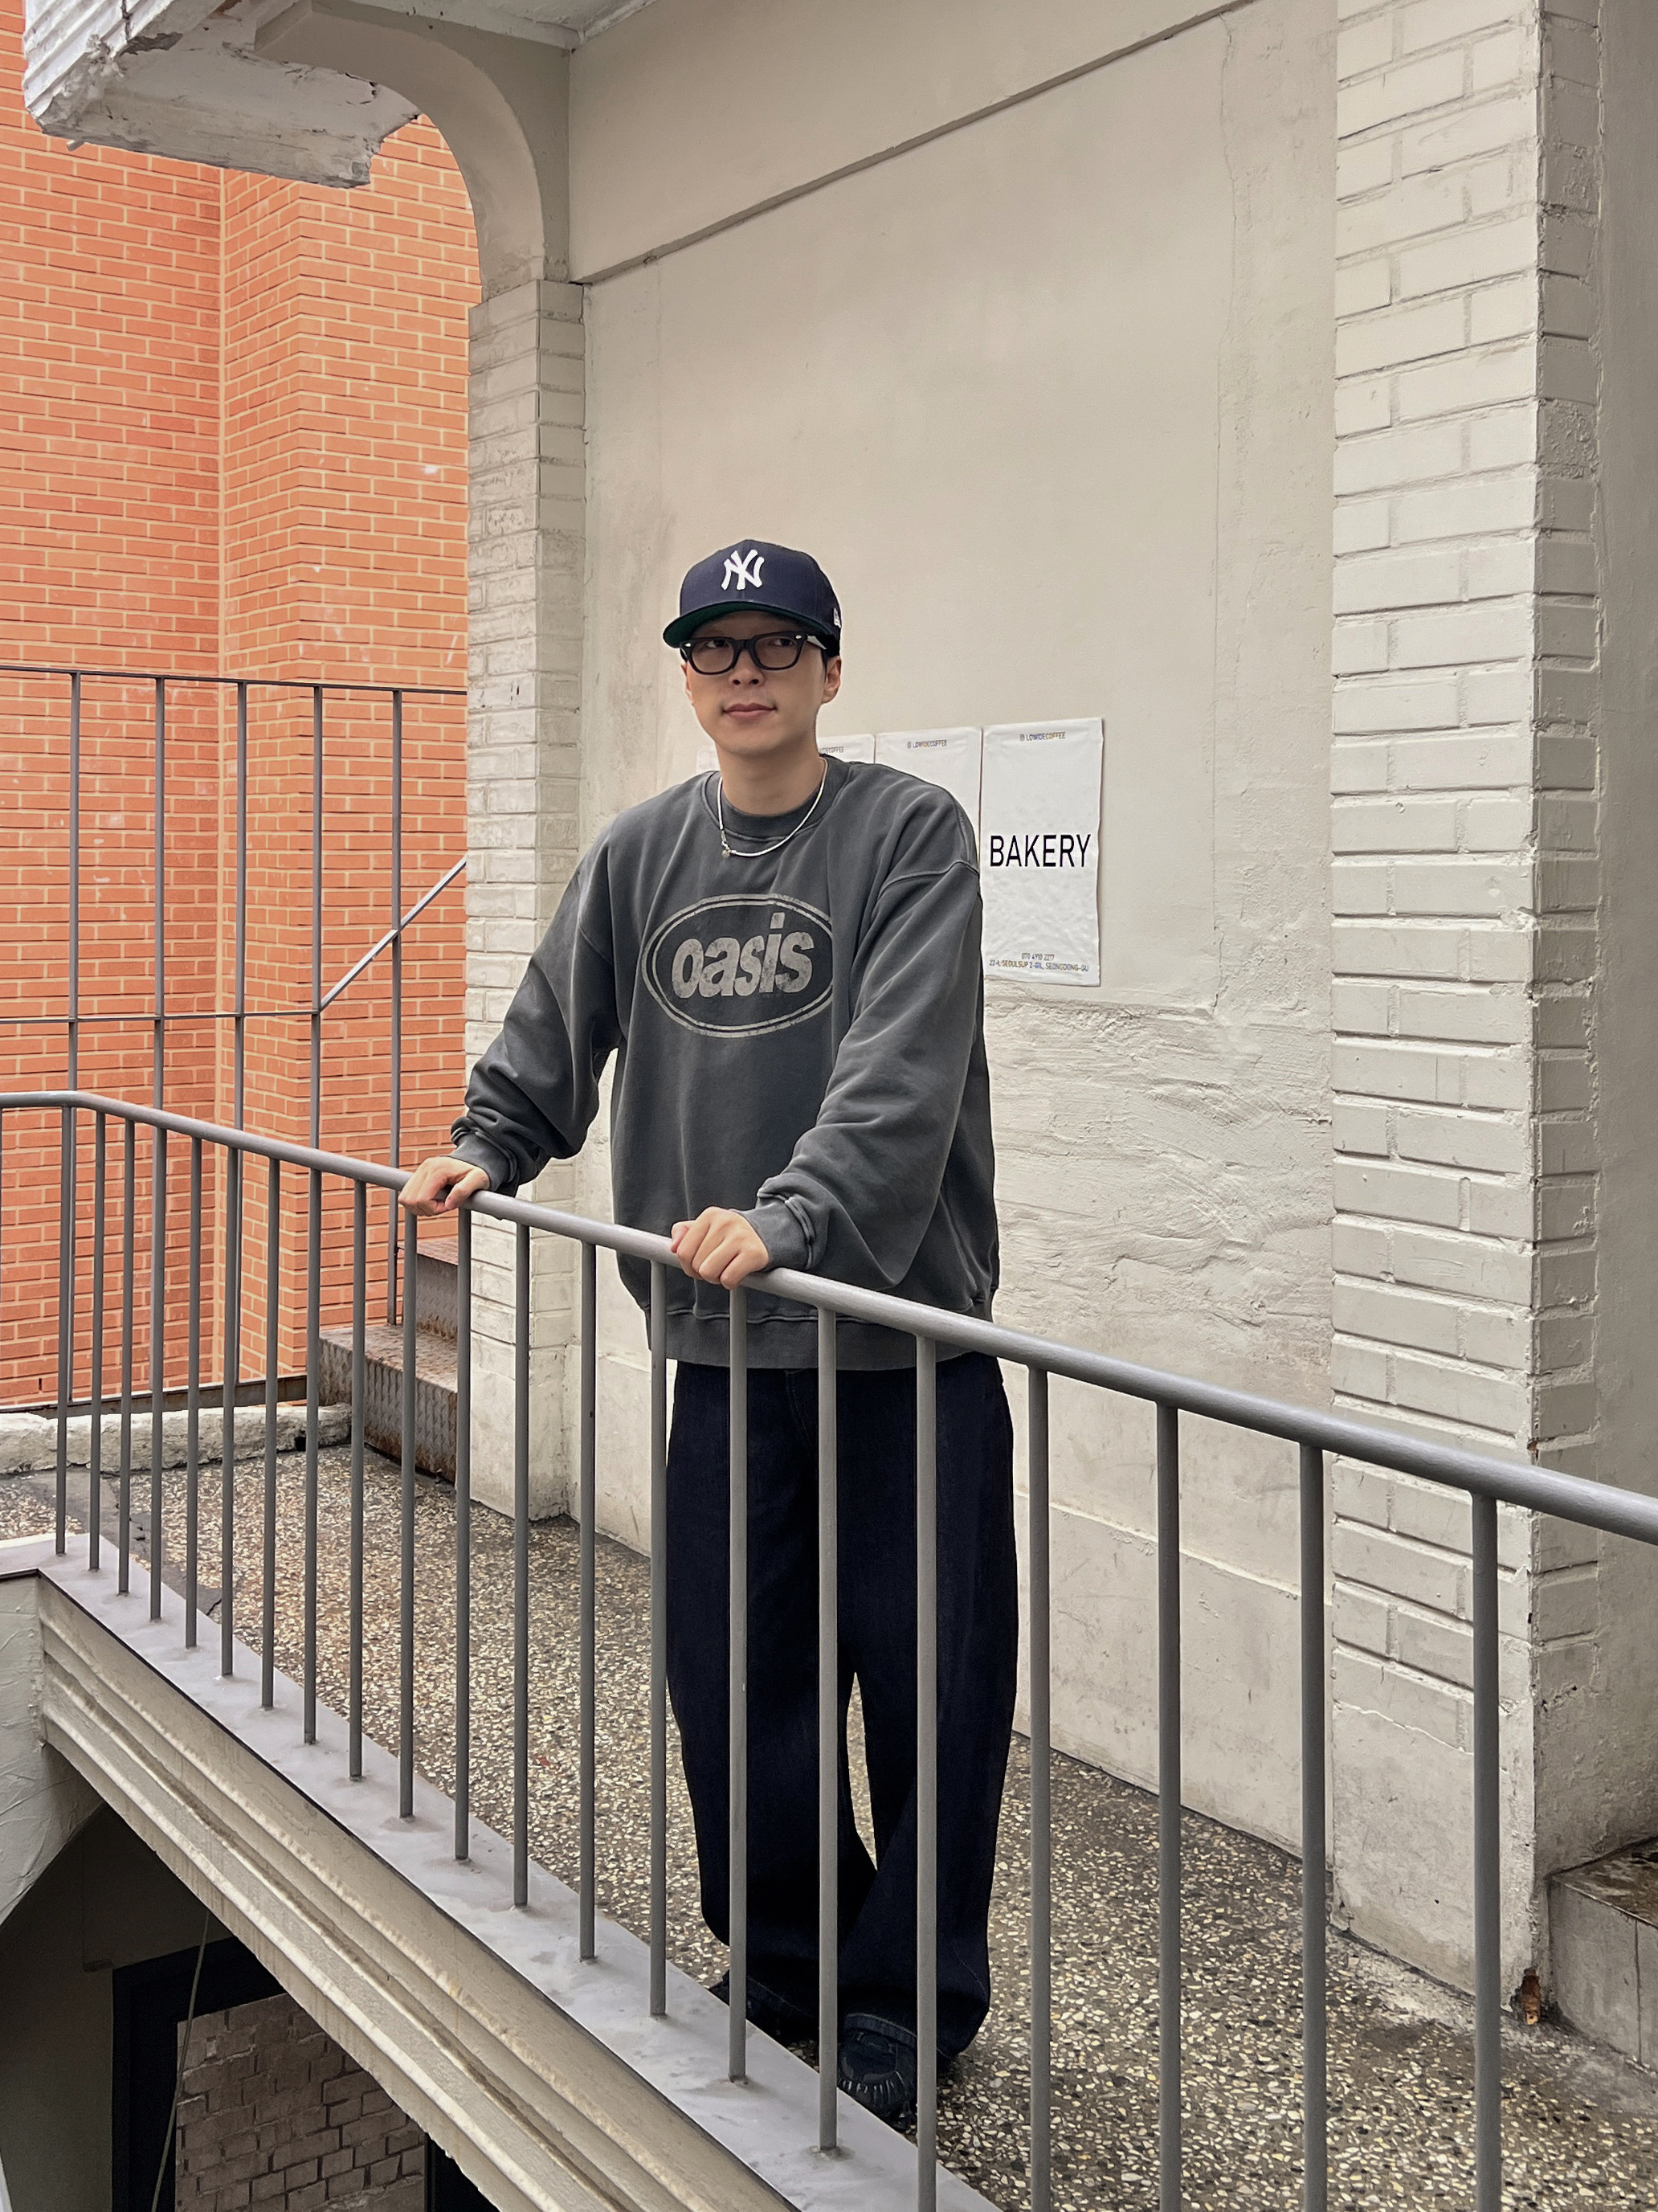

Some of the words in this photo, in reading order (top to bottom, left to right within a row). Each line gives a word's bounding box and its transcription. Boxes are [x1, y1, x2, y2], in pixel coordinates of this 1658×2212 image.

[721, 550, 765, 591] NY
[990, 834, 1091, 867] BAKERY
[672, 912, 815, 999] oasis
